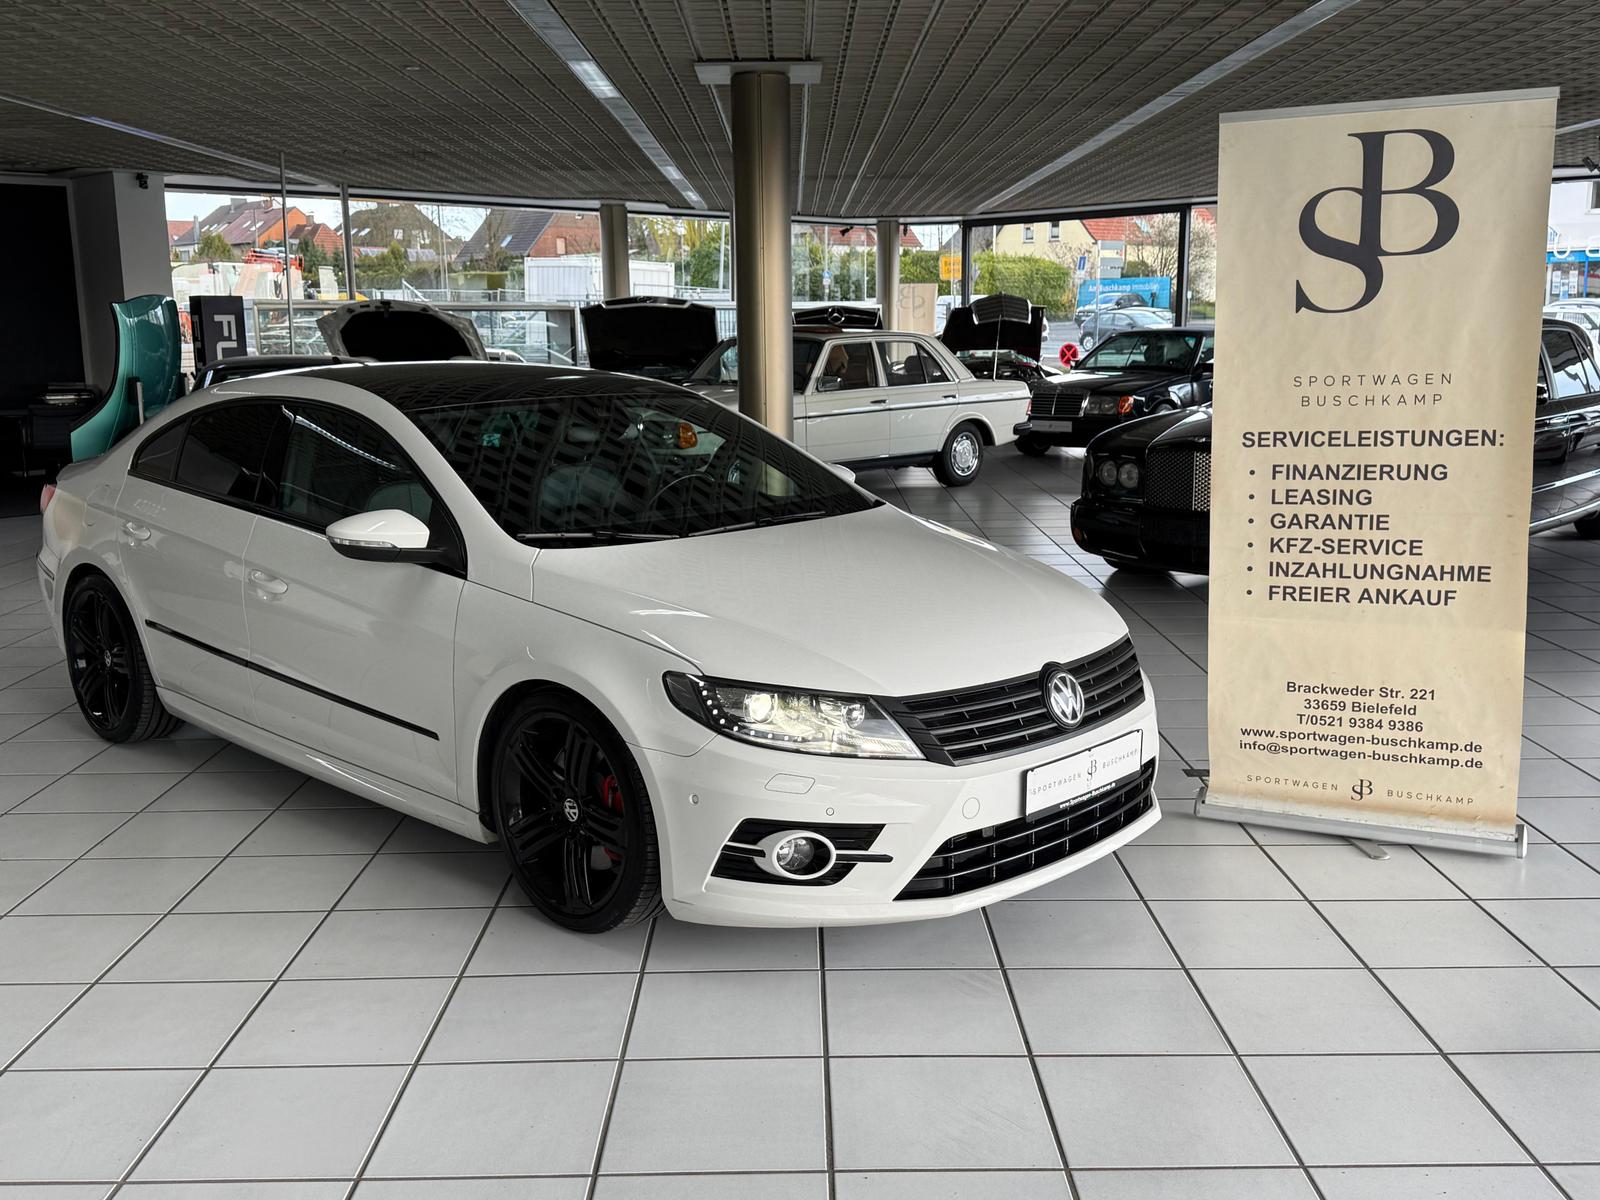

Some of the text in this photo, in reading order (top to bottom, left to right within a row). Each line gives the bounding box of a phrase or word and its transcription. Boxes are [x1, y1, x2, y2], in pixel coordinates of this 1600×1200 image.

[1293, 372, 1453, 388] SPORTWAGEN
[1301, 393, 1444, 407] BUSCHKAMP
[1242, 429, 1505, 448] SERVICELEISTUNGEN:
[1271, 463, 1448, 481] FINANZIERUNG
[1271, 488, 1373, 506] LEASING
[1269, 512, 1390, 531] GARANTIE
[1269, 537, 1424, 556] KFZ-SERVICE
[1268, 560, 1492, 583] INZAHLUNGNAHME
[1268, 585, 1457, 607] FREIER ANKAUF
[1286, 681, 1436, 701] Brackweder Str. 221
[1304, 698, 1417, 716] 33659 Bielefeld
[1297, 713, 1424, 733] T/0521 9384 9386
[1240, 727, 1483, 754] www.sportwagen-buschkamp.de
[1239, 739, 1484, 769] info@sportwagen-buschkamp.de
[1031, 772, 1082, 796] SPORTWAGEN
[1102, 748, 1138, 769] BUSCHKAMP
[1246, 775, 1339, 791] SPORTWAGEN
[1387, 790, 1475, 805] BUSCHKAMP
